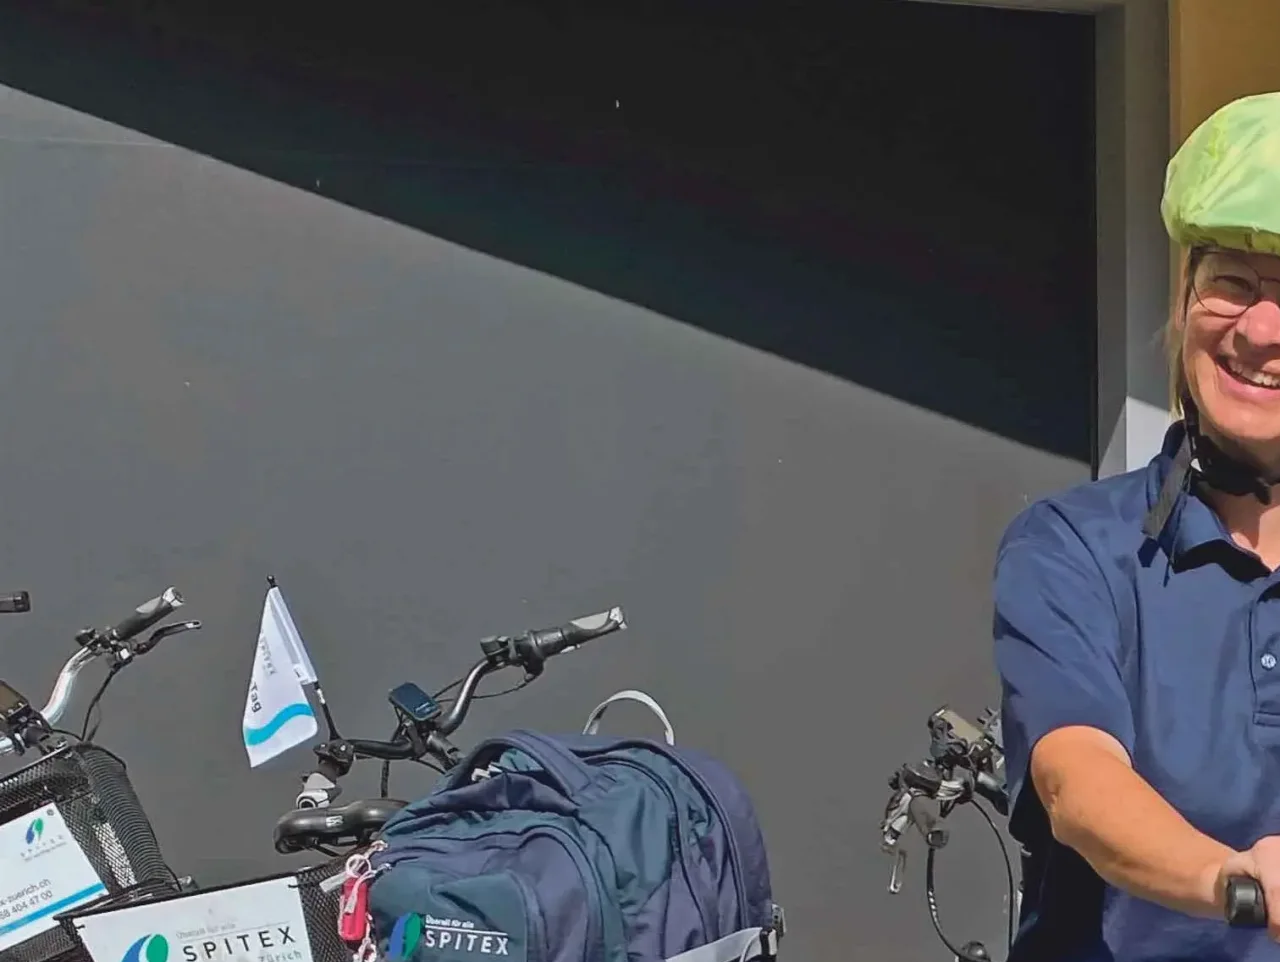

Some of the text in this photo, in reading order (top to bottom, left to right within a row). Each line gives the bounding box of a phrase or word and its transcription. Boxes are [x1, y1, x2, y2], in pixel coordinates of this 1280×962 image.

[11, 901, 28, 913] 404
[29, 895, 39, 905] 47
[40, 889, 53, 901] 00
[183, 926, 296, 962] SPITEX
[425, 930, 509, 956] SPITEX
